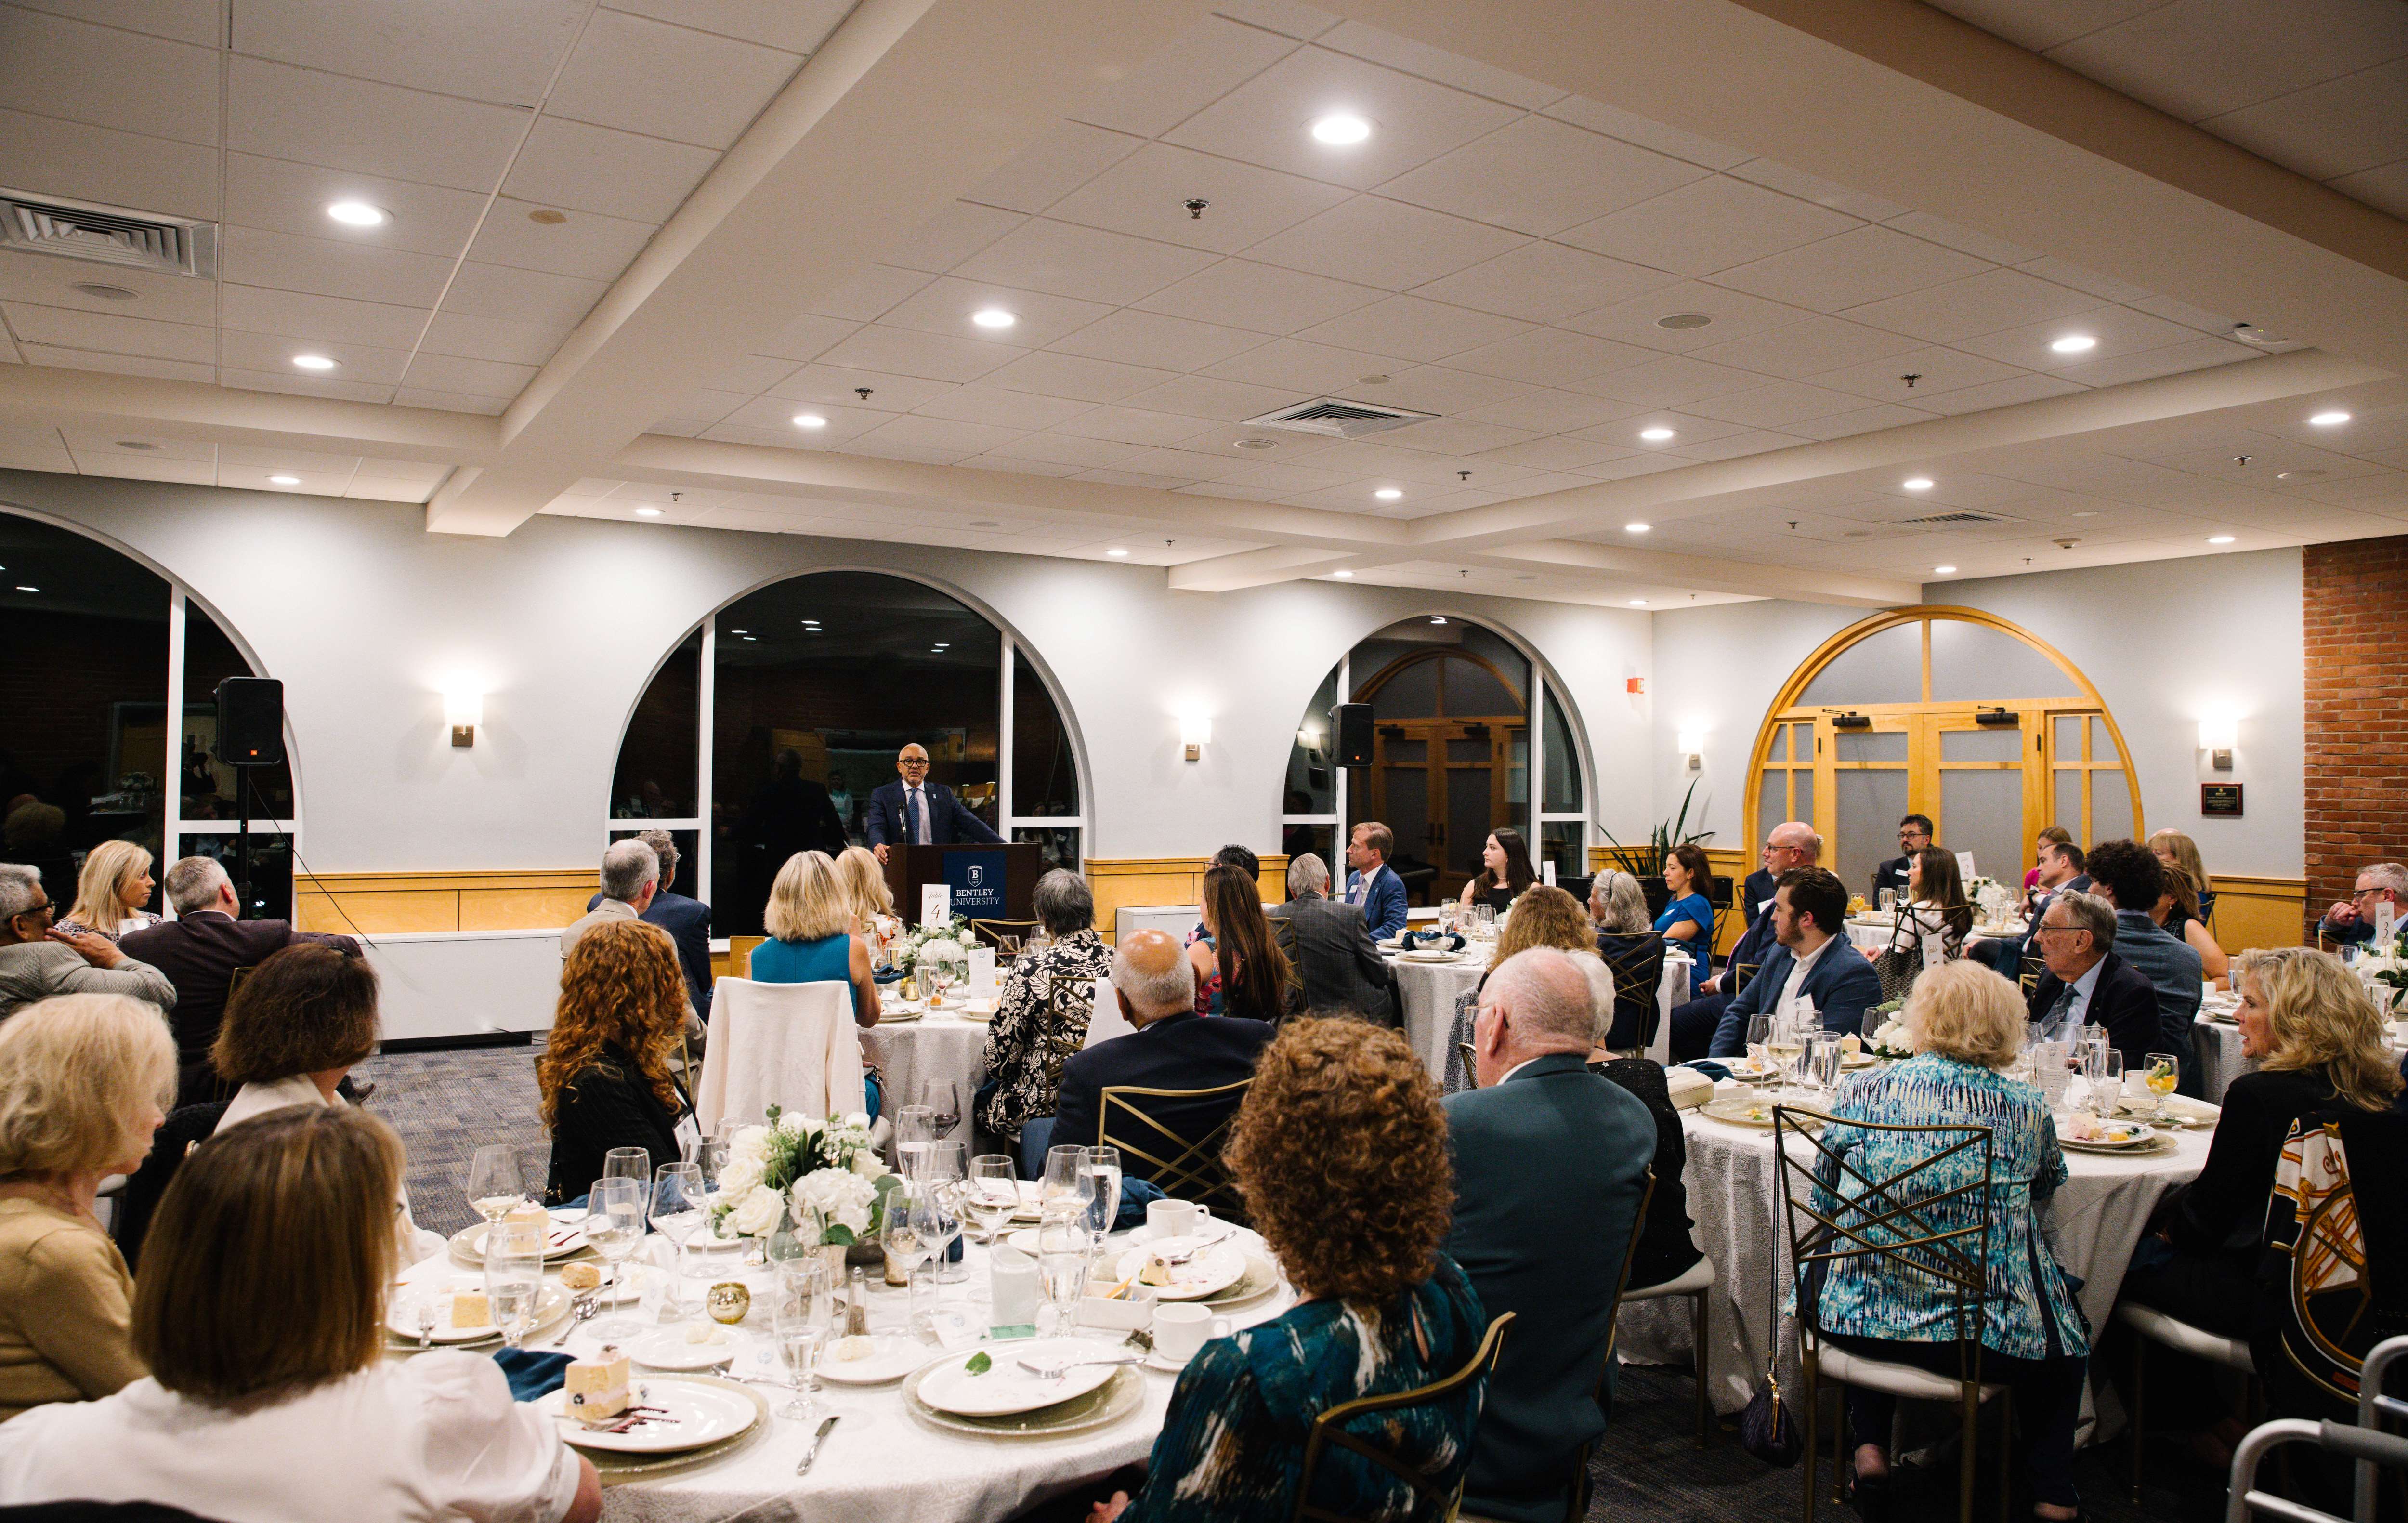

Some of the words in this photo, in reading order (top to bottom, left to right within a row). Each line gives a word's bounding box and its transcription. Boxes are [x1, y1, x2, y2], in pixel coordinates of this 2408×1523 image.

[972, 870, 979, 879] B
[929, 891, 943, 900] Table
[956, 889, 994, 897] BENTLEY
[950, 897, 1000, 906] UNIVERSITY
[931, 904, 940, 919] 4
[2382, 922, 2388, 938] 3
[1927, 944, 1938, 956] Table
